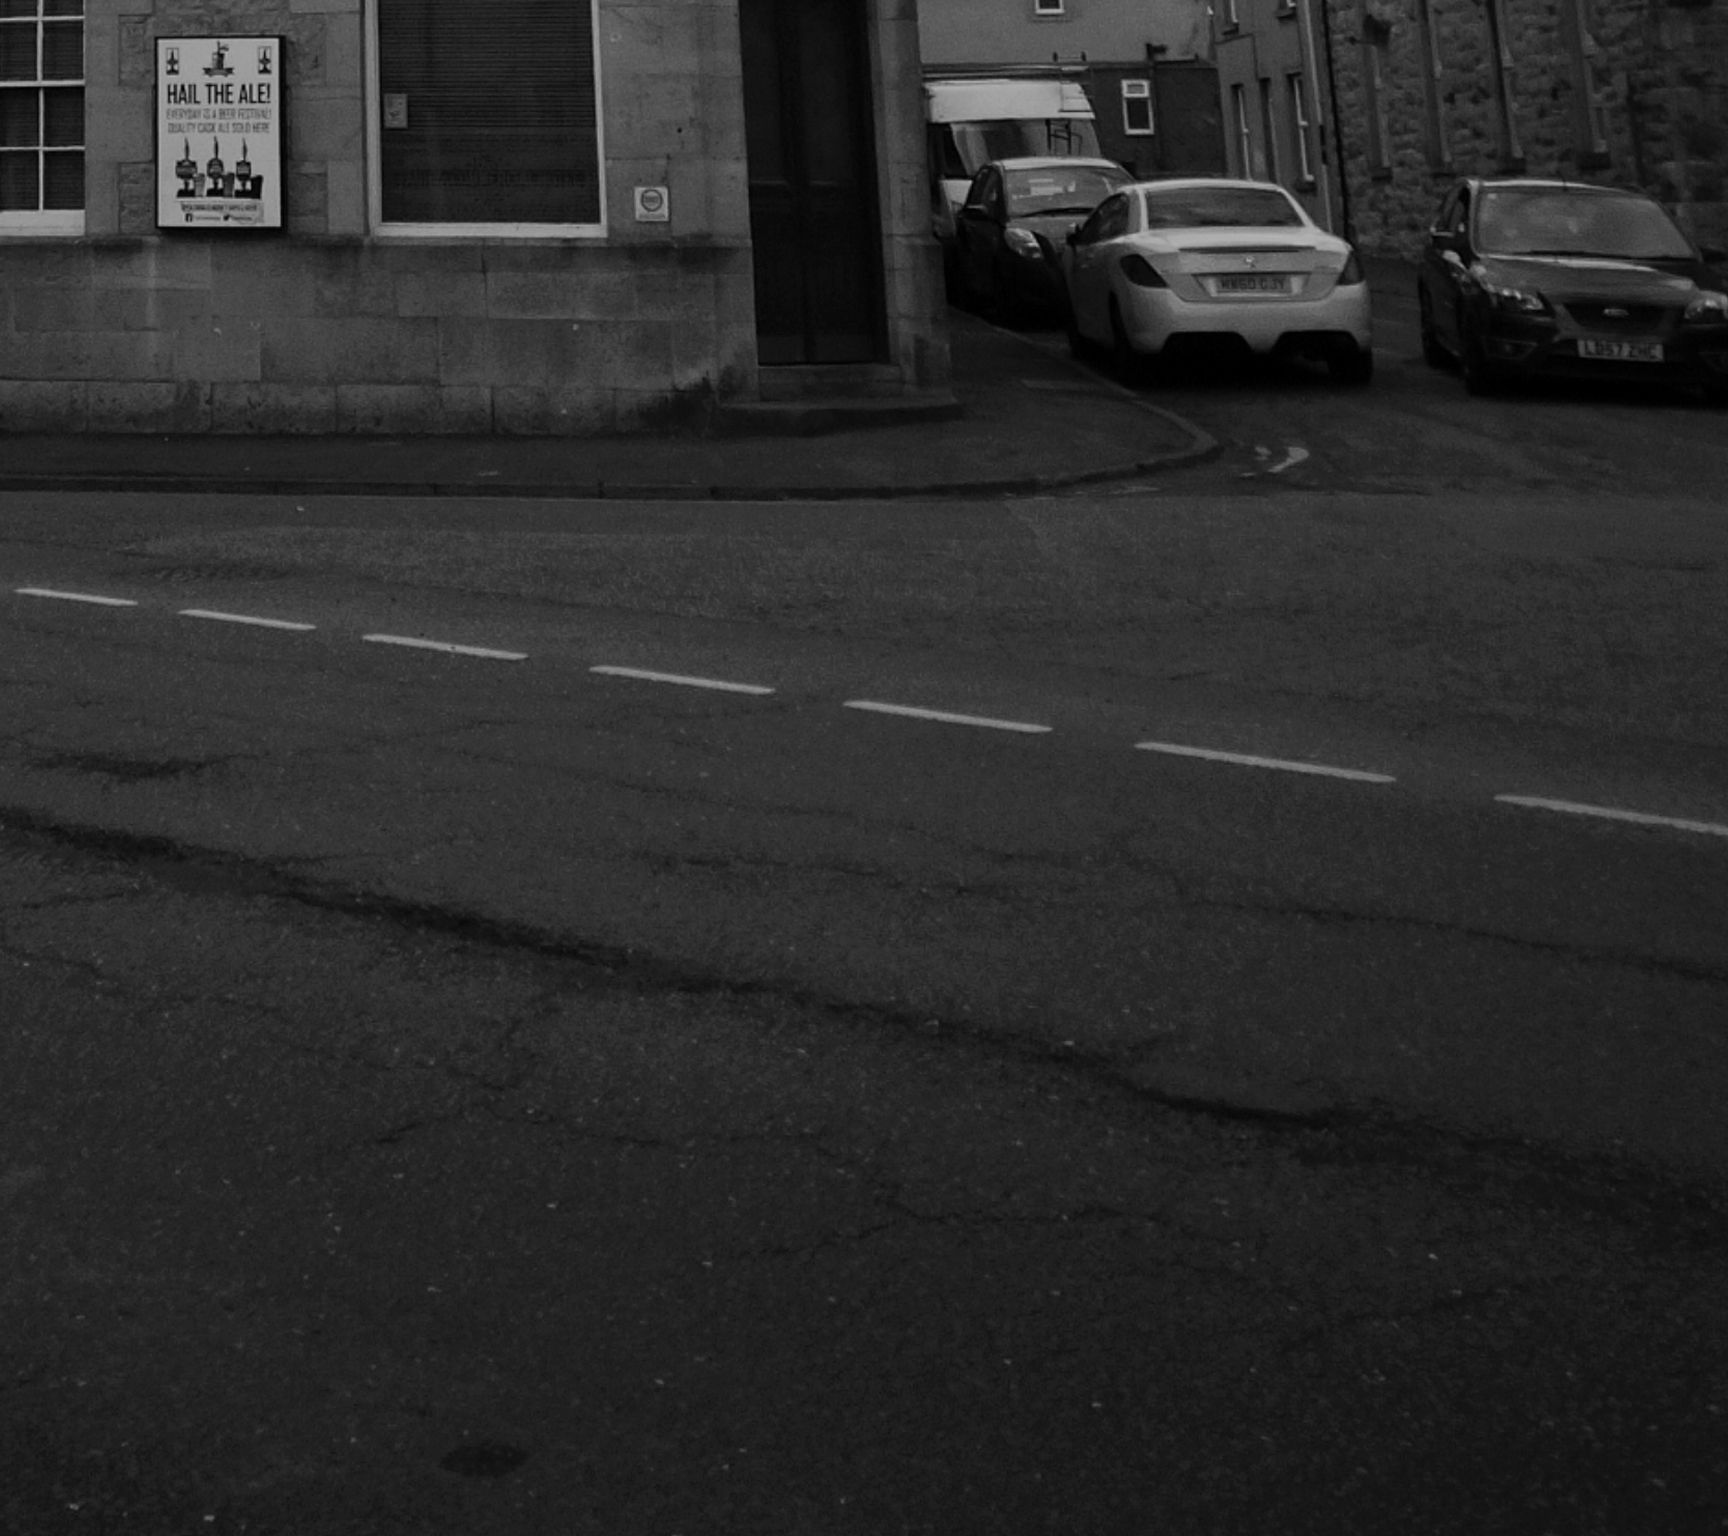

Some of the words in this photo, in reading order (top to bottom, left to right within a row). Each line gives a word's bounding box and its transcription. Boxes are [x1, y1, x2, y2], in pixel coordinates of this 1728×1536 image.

[167, 83, 201, 104] HAIL
[205, 83, 234, 104] THE
[239, 83, 271, 104] ALE!
